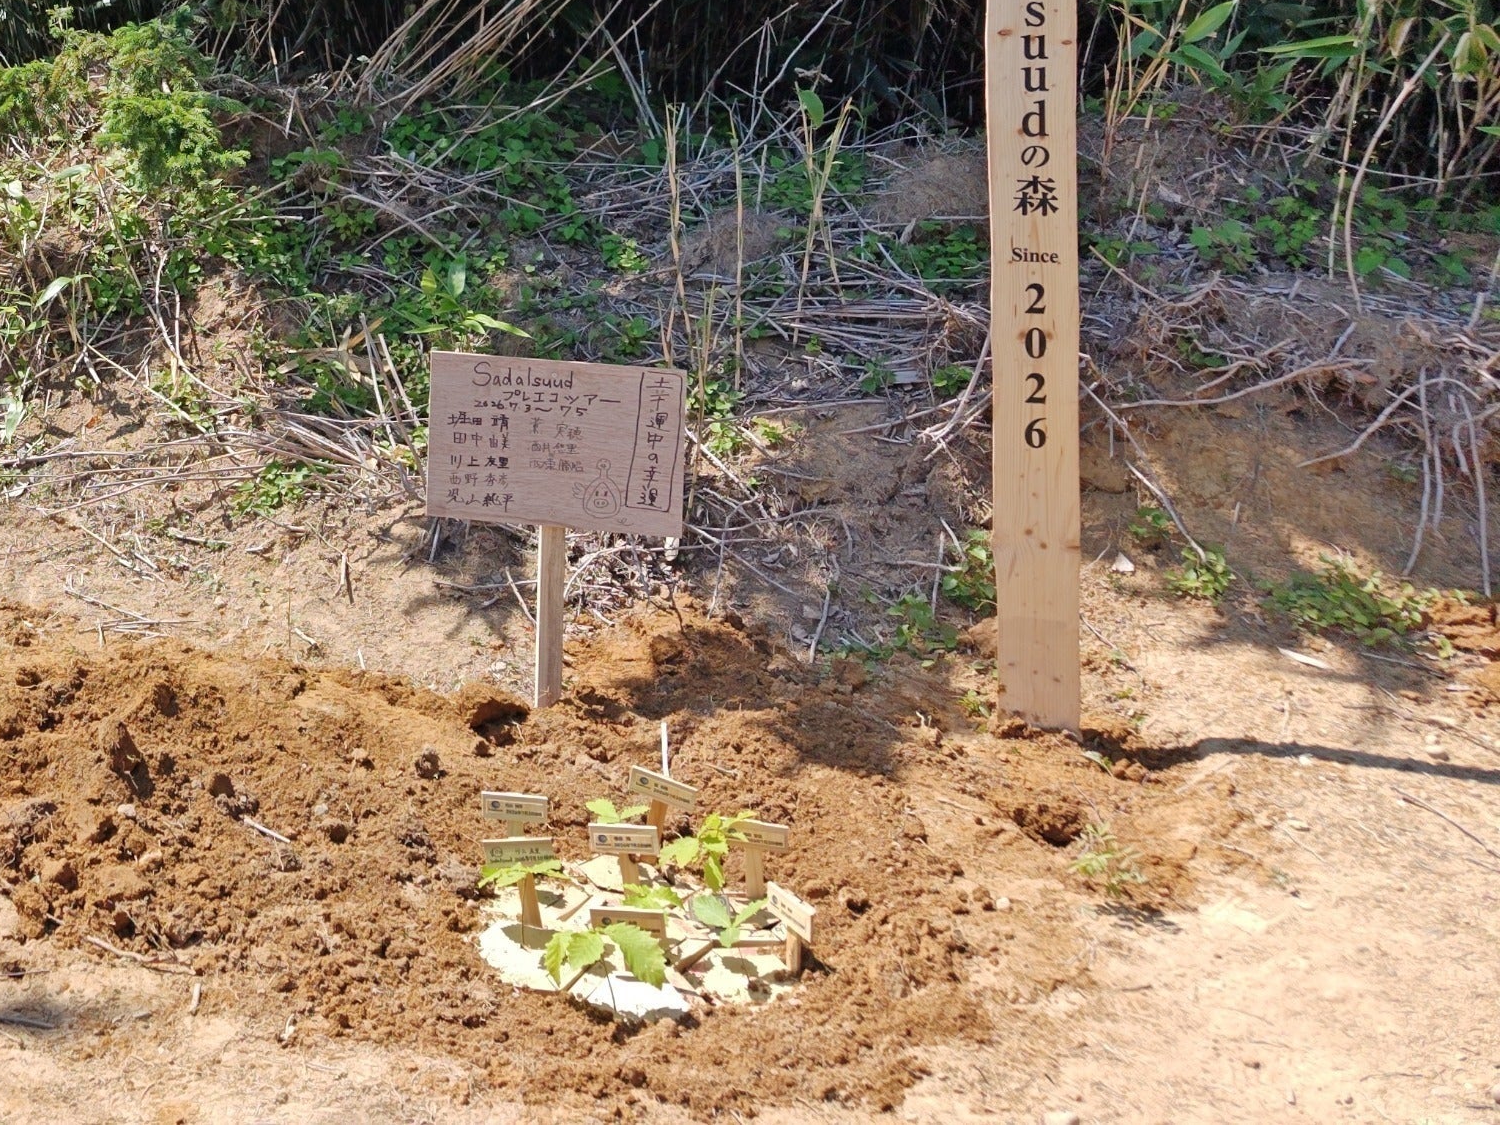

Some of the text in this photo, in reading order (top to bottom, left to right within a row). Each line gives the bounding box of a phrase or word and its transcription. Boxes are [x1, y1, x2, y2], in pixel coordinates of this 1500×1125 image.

[1011, 247, 1060, 264] Since
[472, 362, 574, 389] Sadalsuud
[1024, 283, 1048, 449] 2026
[503, 389, 621, 407] プレエコツアー
